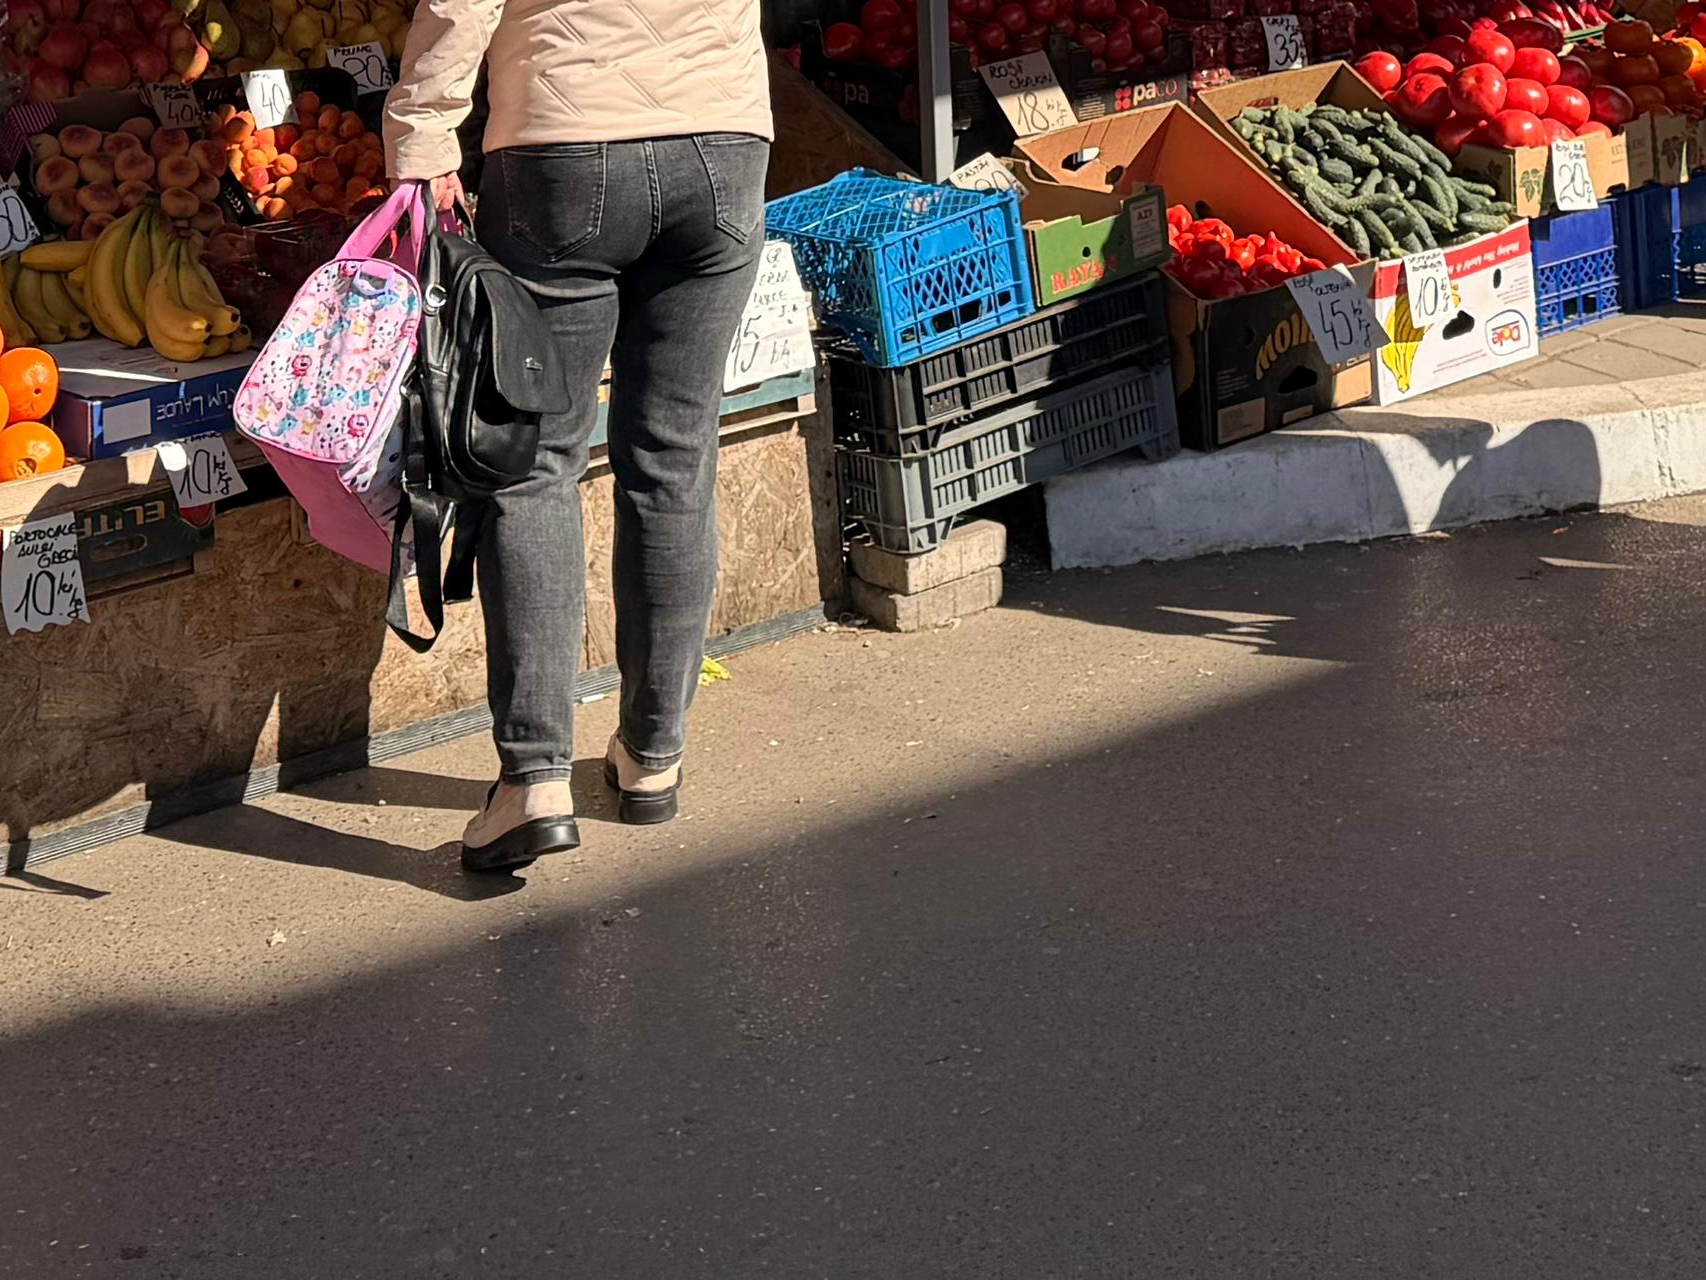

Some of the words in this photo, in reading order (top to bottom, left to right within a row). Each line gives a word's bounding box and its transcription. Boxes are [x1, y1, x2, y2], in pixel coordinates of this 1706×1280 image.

[1274, 32, 1300, 66] 35
[261, 83, 285, 122] 40
[1132, 78, 1178, 106] paco
[1491, 324, 1521, 347] Dole
[156, 394, 205, 421] LAUDE
